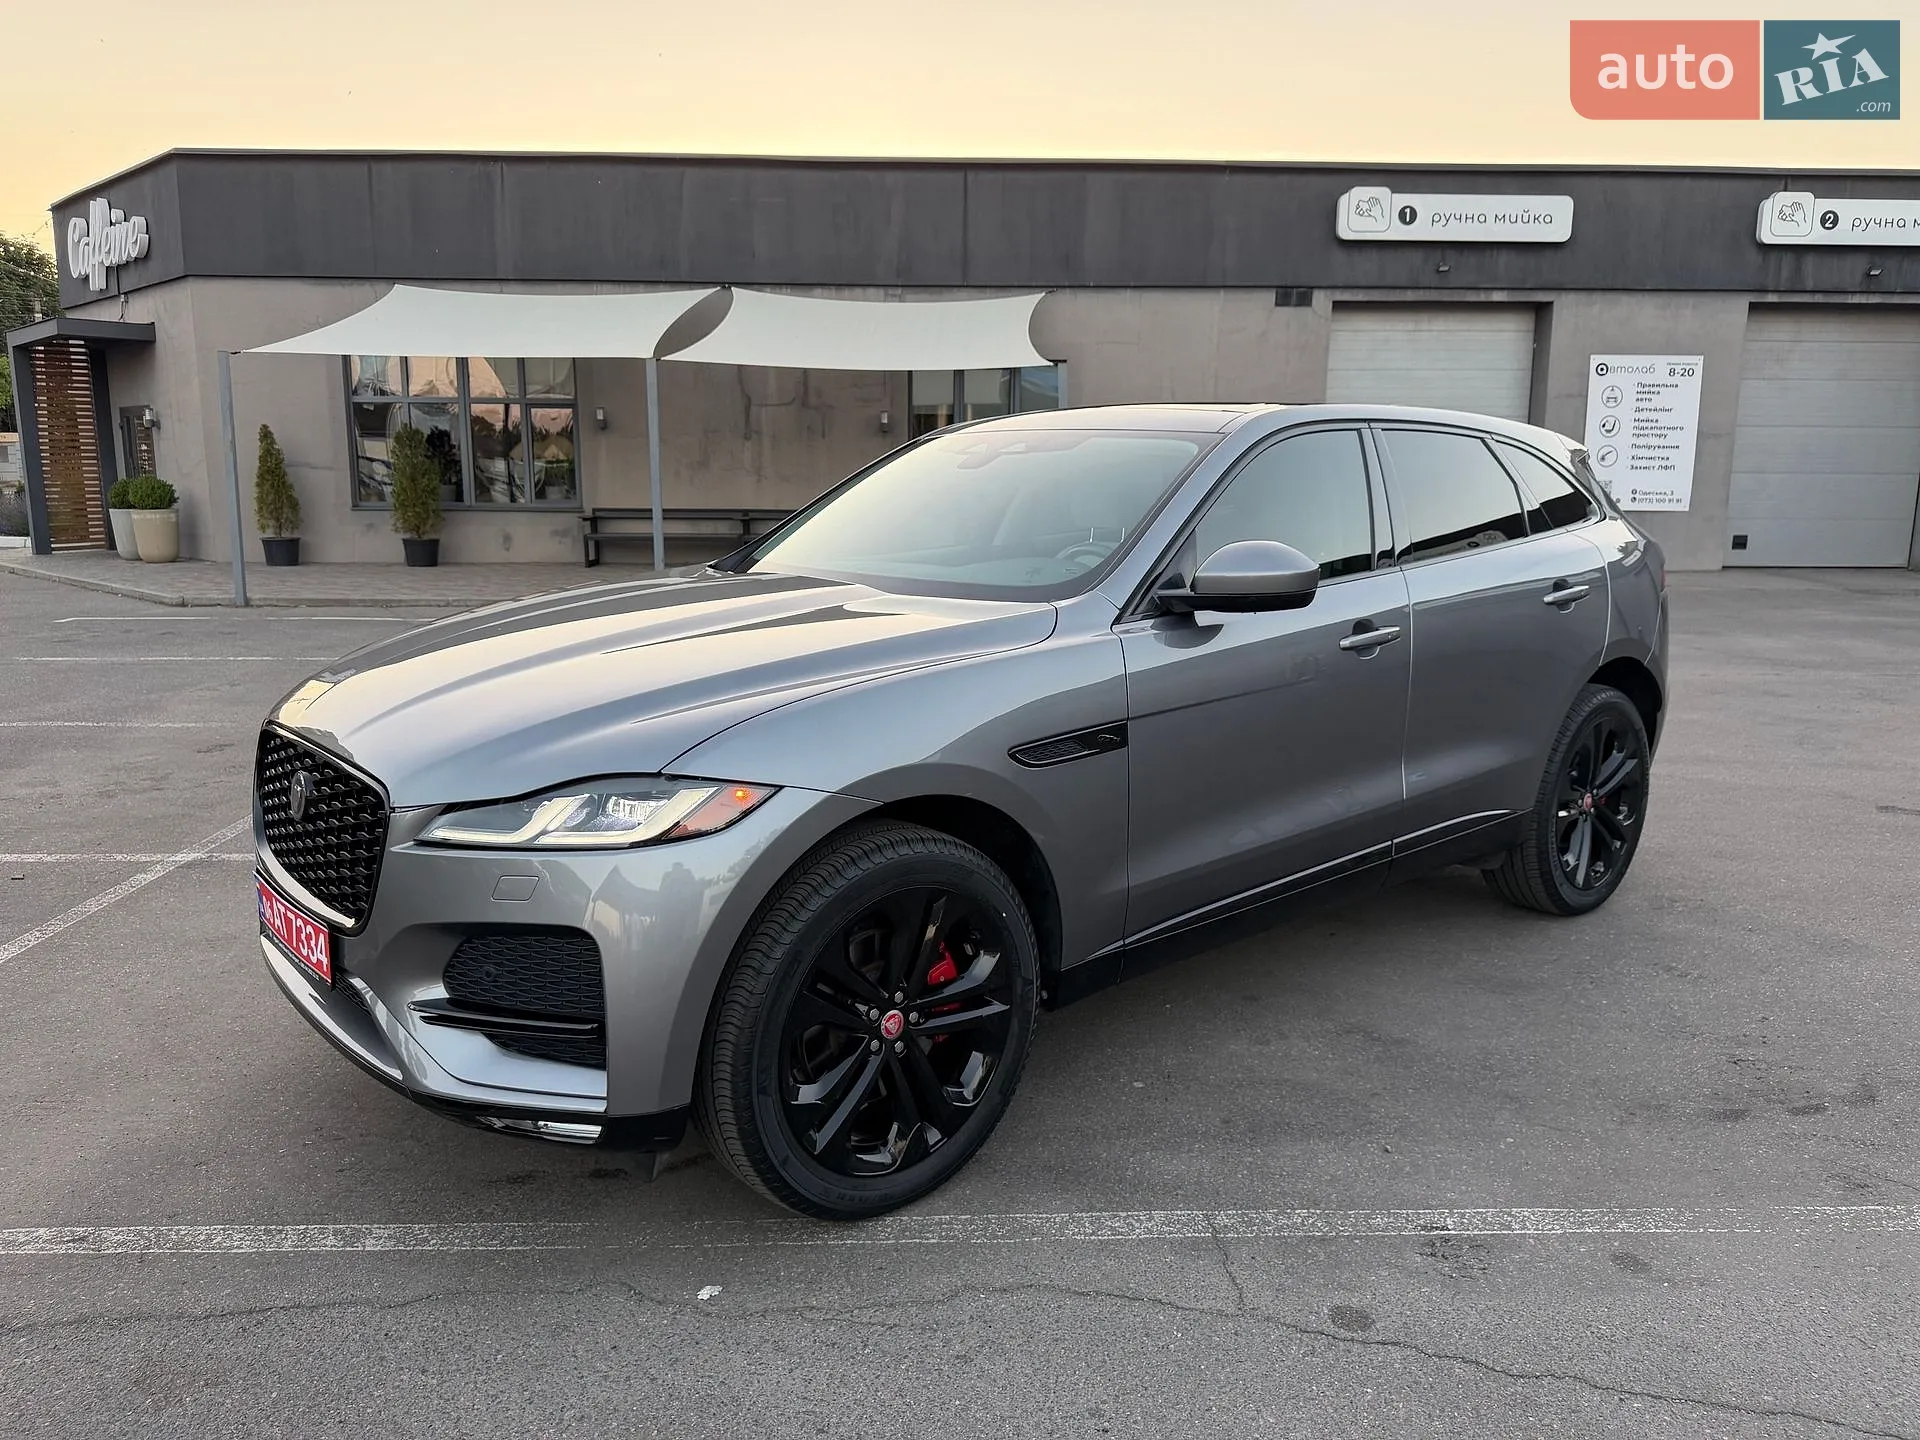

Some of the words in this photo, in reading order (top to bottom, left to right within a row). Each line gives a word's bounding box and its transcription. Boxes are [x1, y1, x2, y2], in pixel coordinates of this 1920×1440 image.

[1431, 213, 1487, 228] ручна
[1494, 210, 1553, 225] мийка
[1851, 217, 1907, 232] ручна
[1668, 367, 1695, 378] 8-20
[286, 909, 328, 972] 7334
